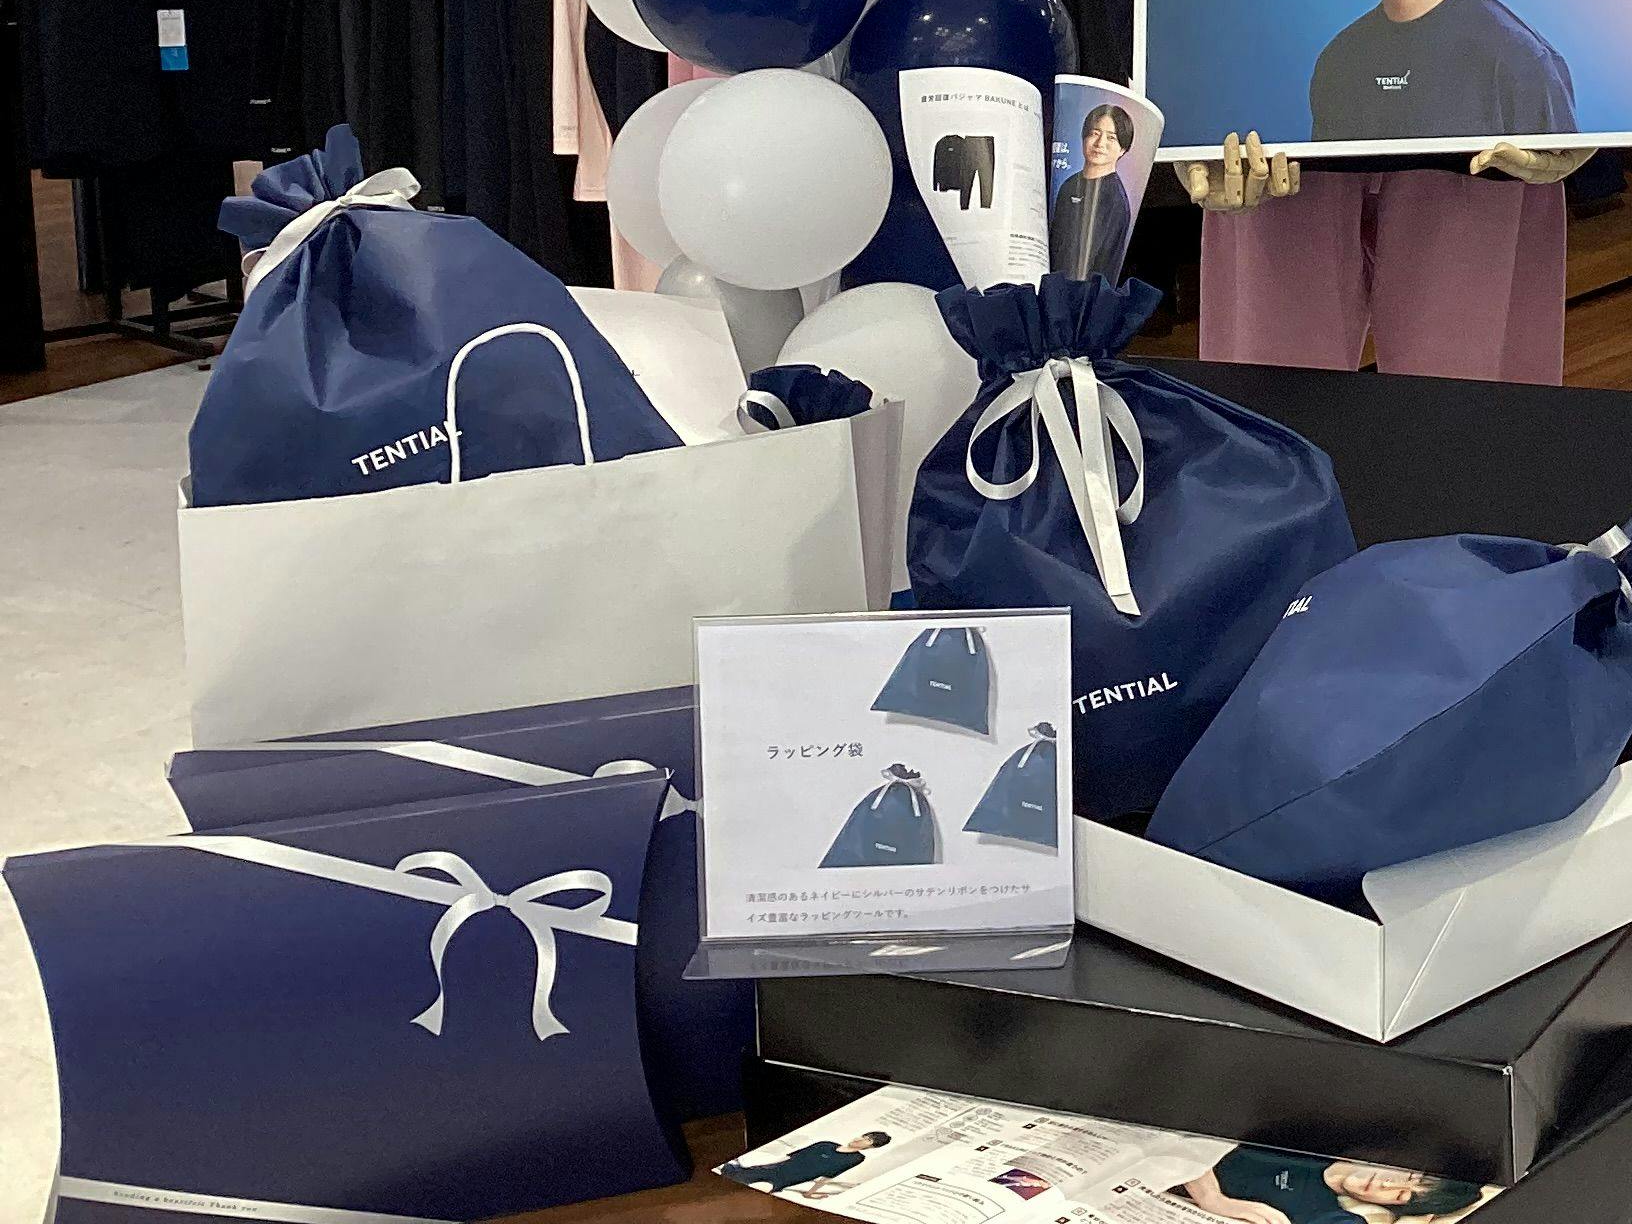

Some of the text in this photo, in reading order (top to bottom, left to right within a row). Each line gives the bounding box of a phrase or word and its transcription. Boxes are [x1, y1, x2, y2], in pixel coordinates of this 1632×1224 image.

[1072, 672, 1178, 715] TENTIAL
[766, 742, 864, 759] ラッピング袋
